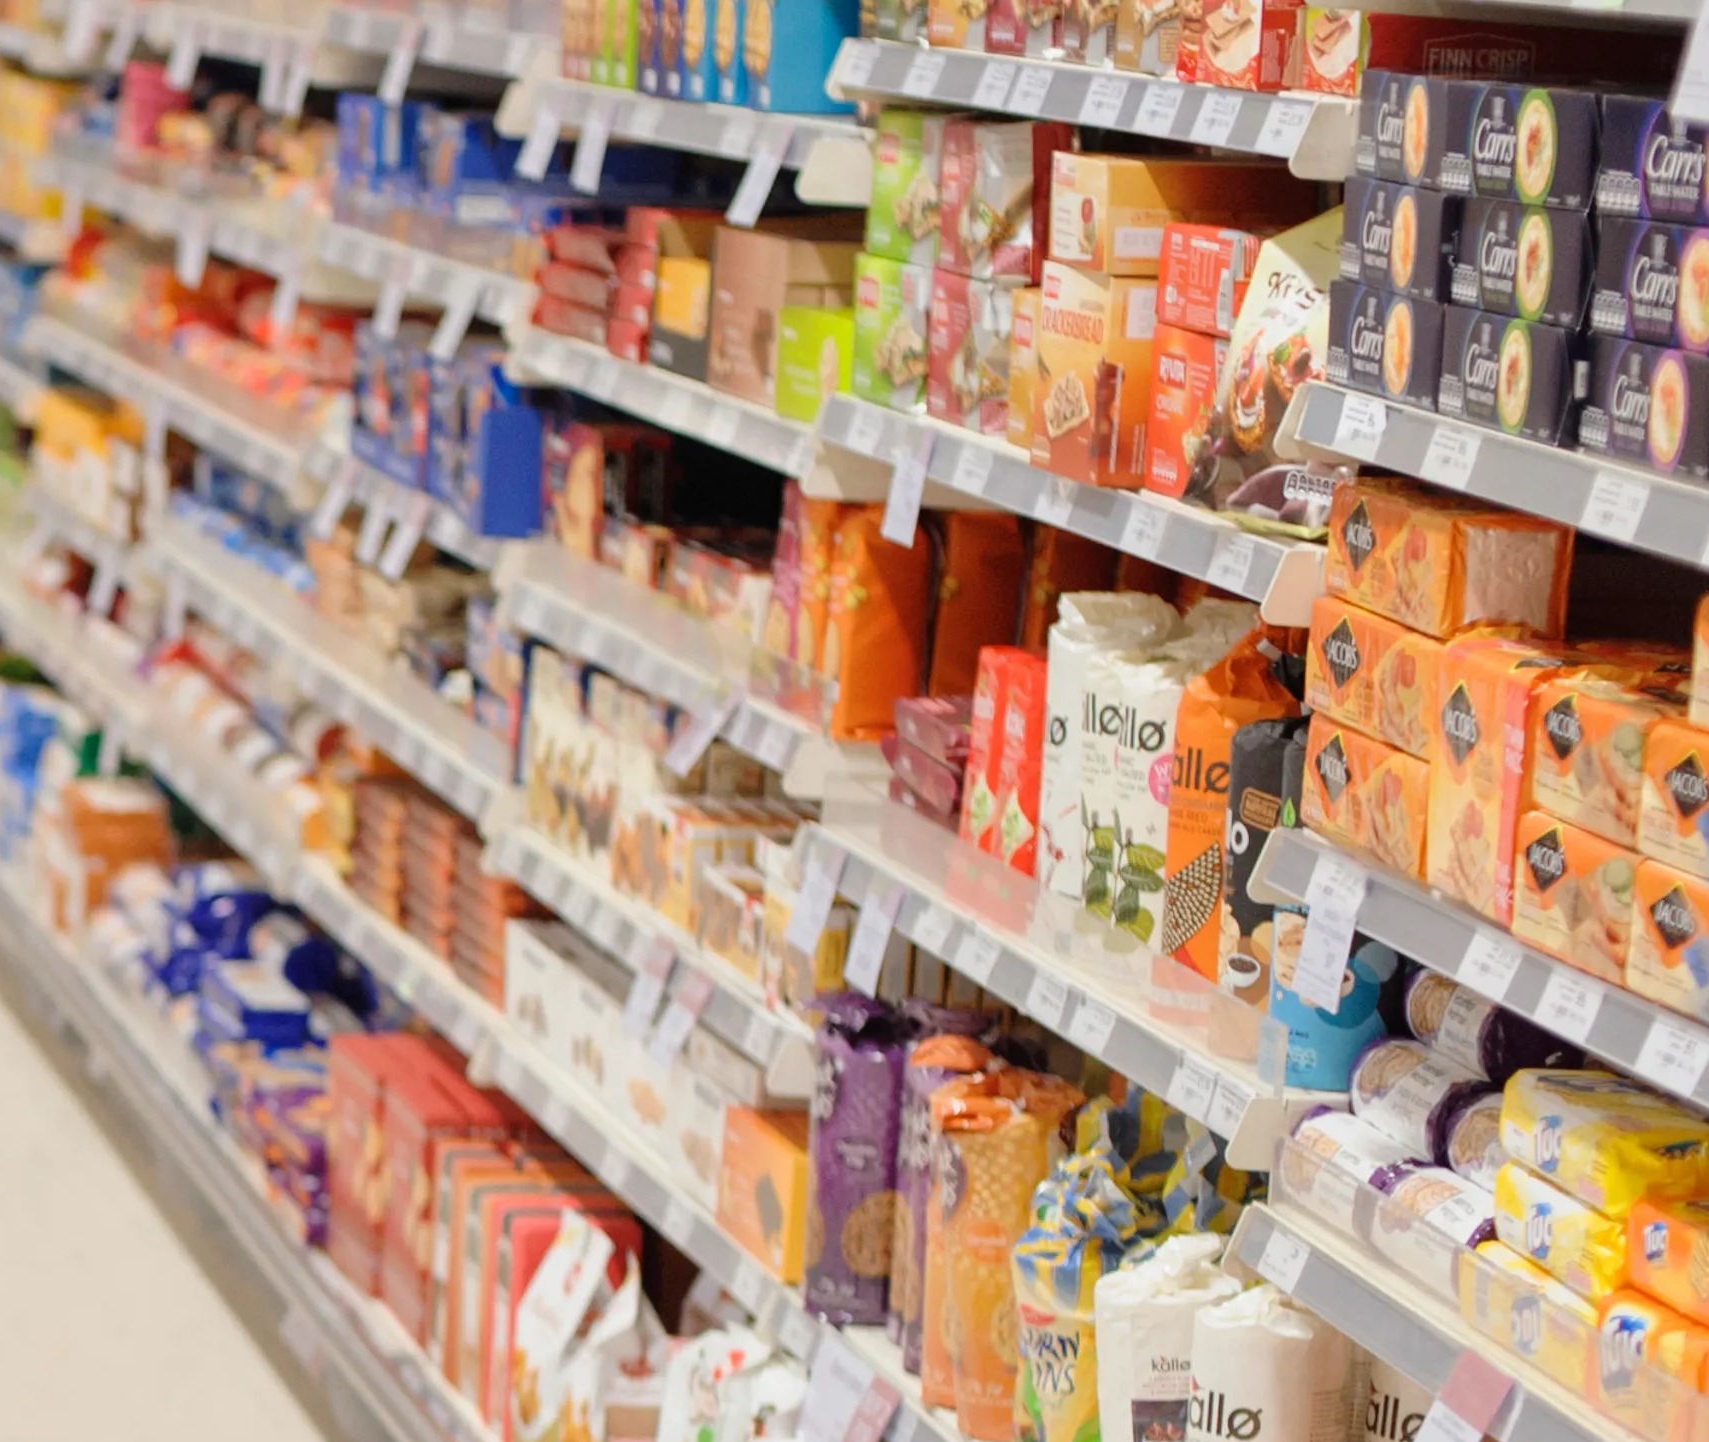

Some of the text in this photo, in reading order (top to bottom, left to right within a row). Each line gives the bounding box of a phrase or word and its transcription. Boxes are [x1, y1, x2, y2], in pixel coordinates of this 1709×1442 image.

[1428, 48, 1528, 71] FINN CRISP
[1378, 103, 1403, 142] Carr's
[1474, 119, 1516, 163] Carr's
[1648, 136, 1703, 182] Carr's
[1363, 213, 1391, 252] Carr's
[1482, 232, 1517, 276] Carr's
[1633, 256, 1678, 305] Carr's
[1351, 316, 1384, 358] Carr's
[1465, 344, 1499, 390] Carr's
[1613, 374, 1650, 423] Carr's
